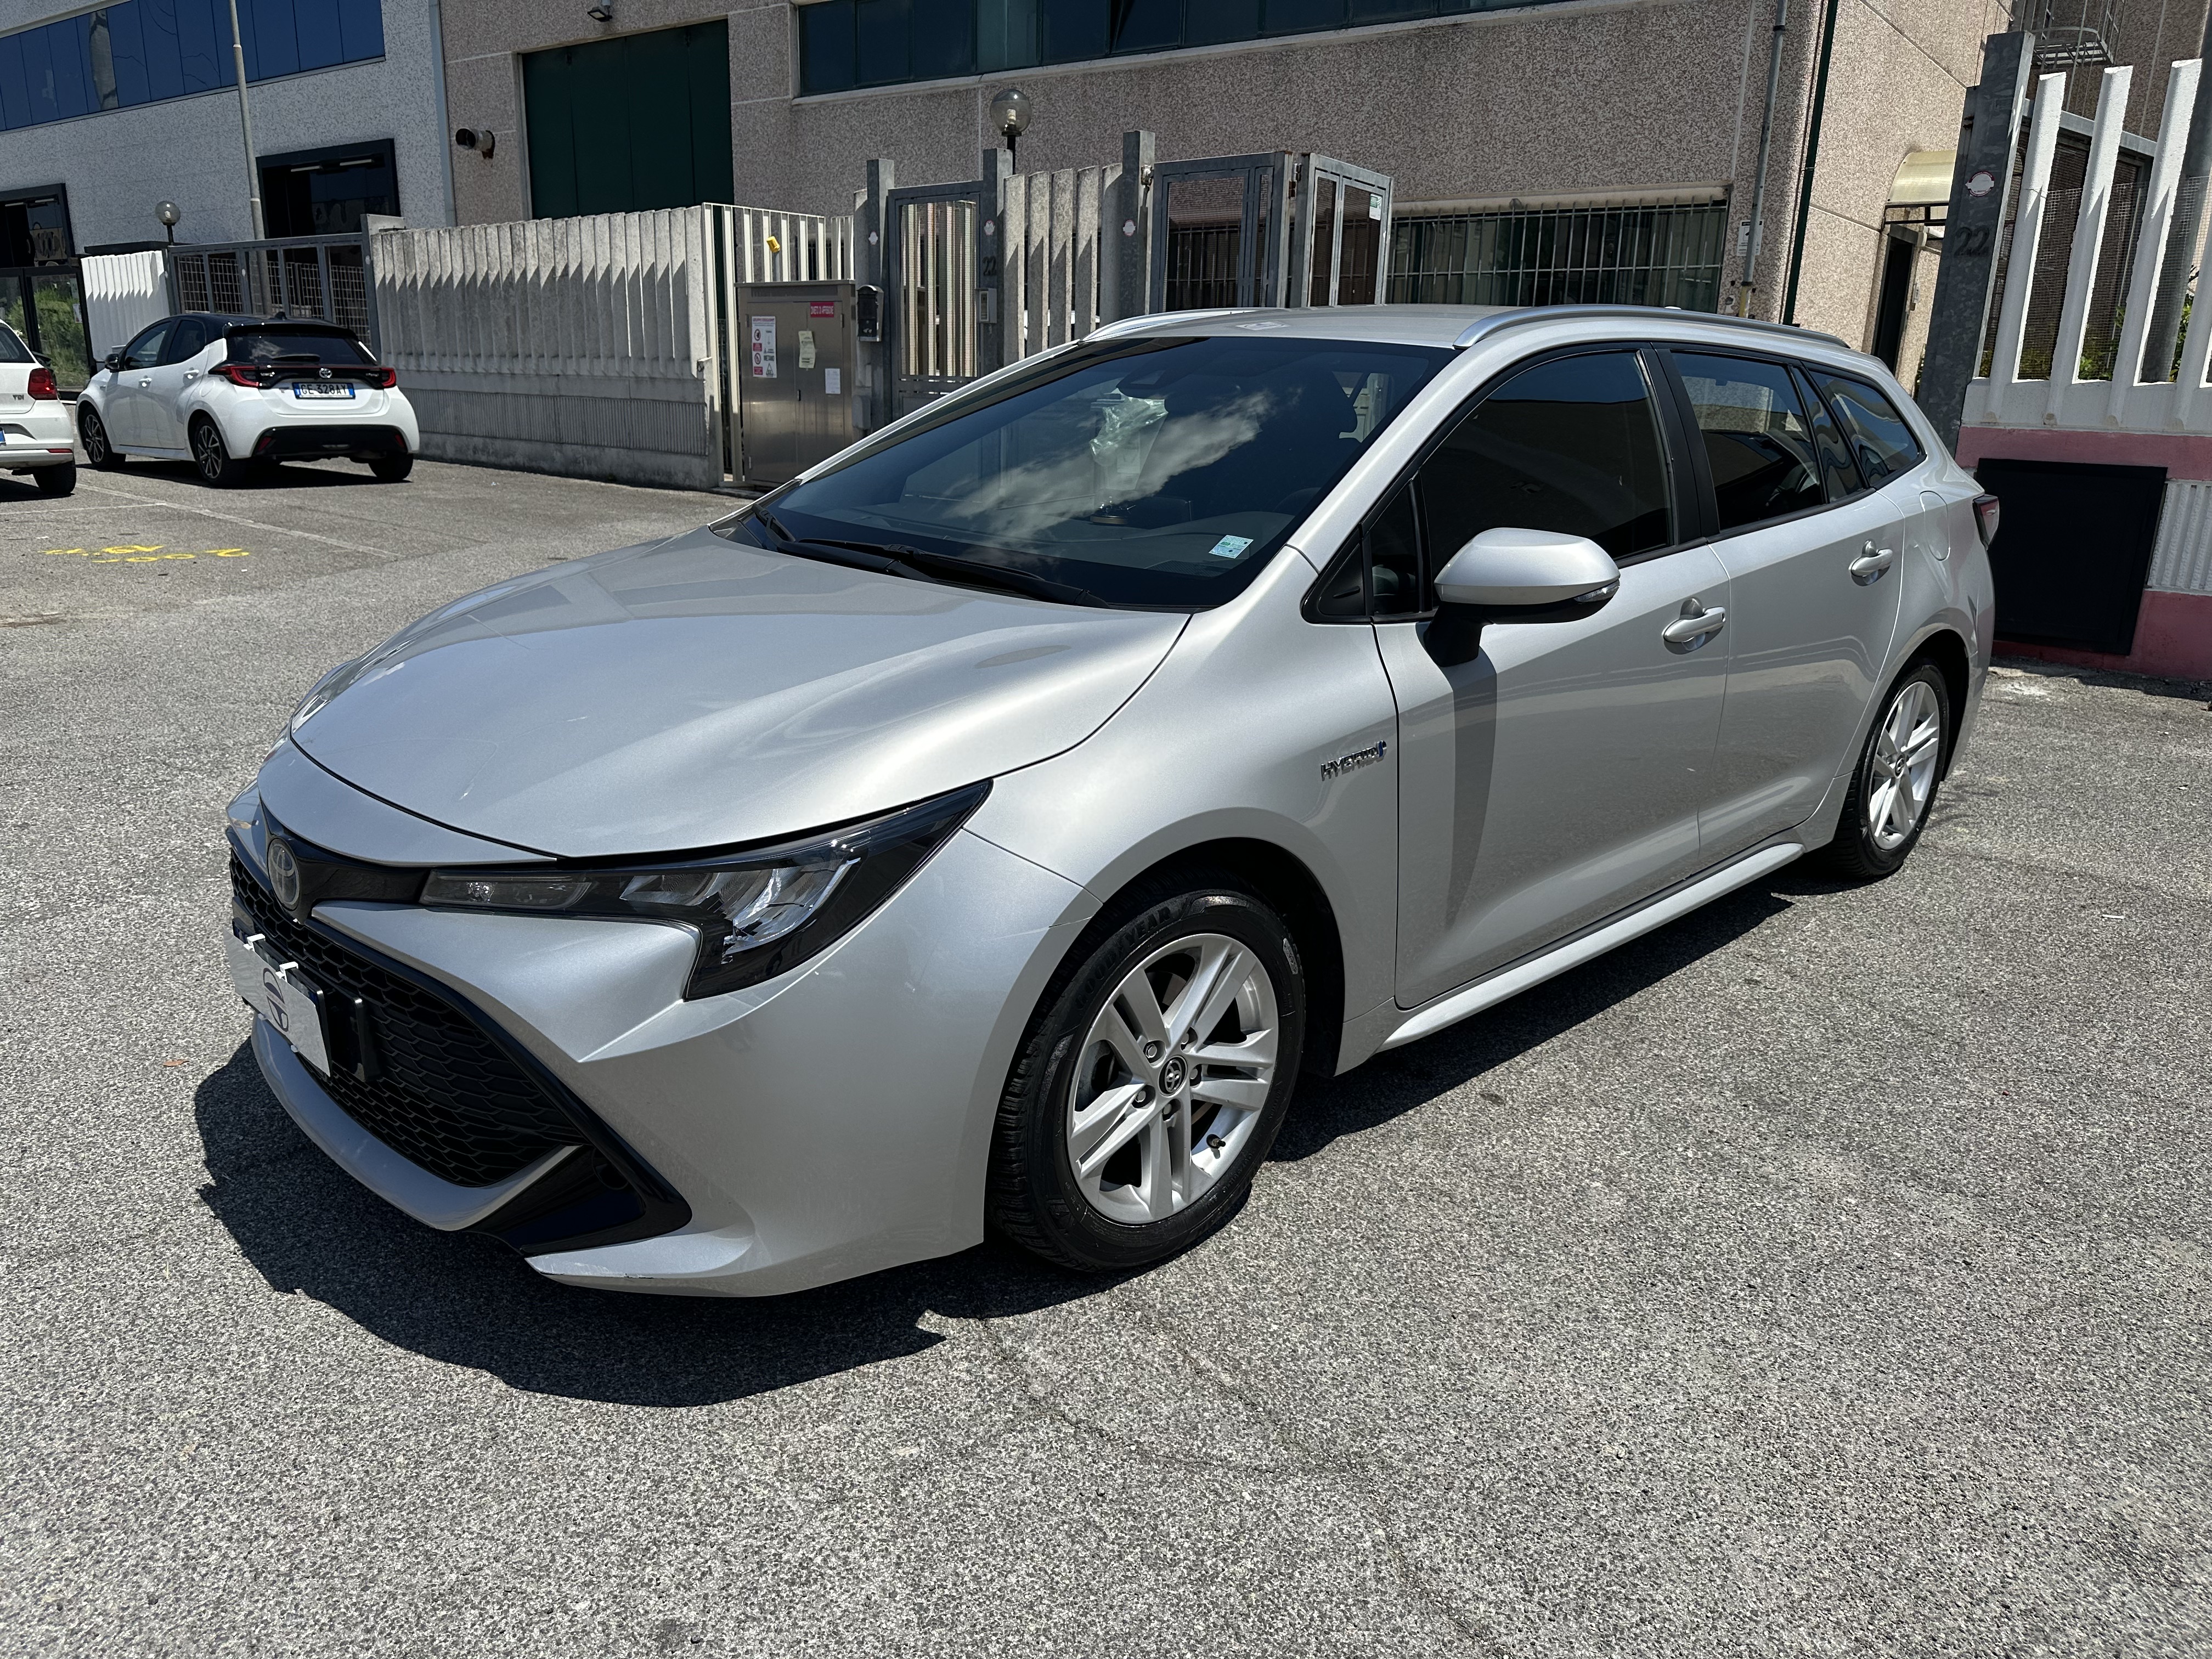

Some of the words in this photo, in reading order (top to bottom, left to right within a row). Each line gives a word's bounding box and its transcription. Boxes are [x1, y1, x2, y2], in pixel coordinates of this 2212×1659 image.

[1954, 226, 1990, 257] 22
[982, 256, 997, 276] 22
[1321, 746, 1379, 780] HYBRID
[1074, 905, 1172, 1011] GOODYEAR
